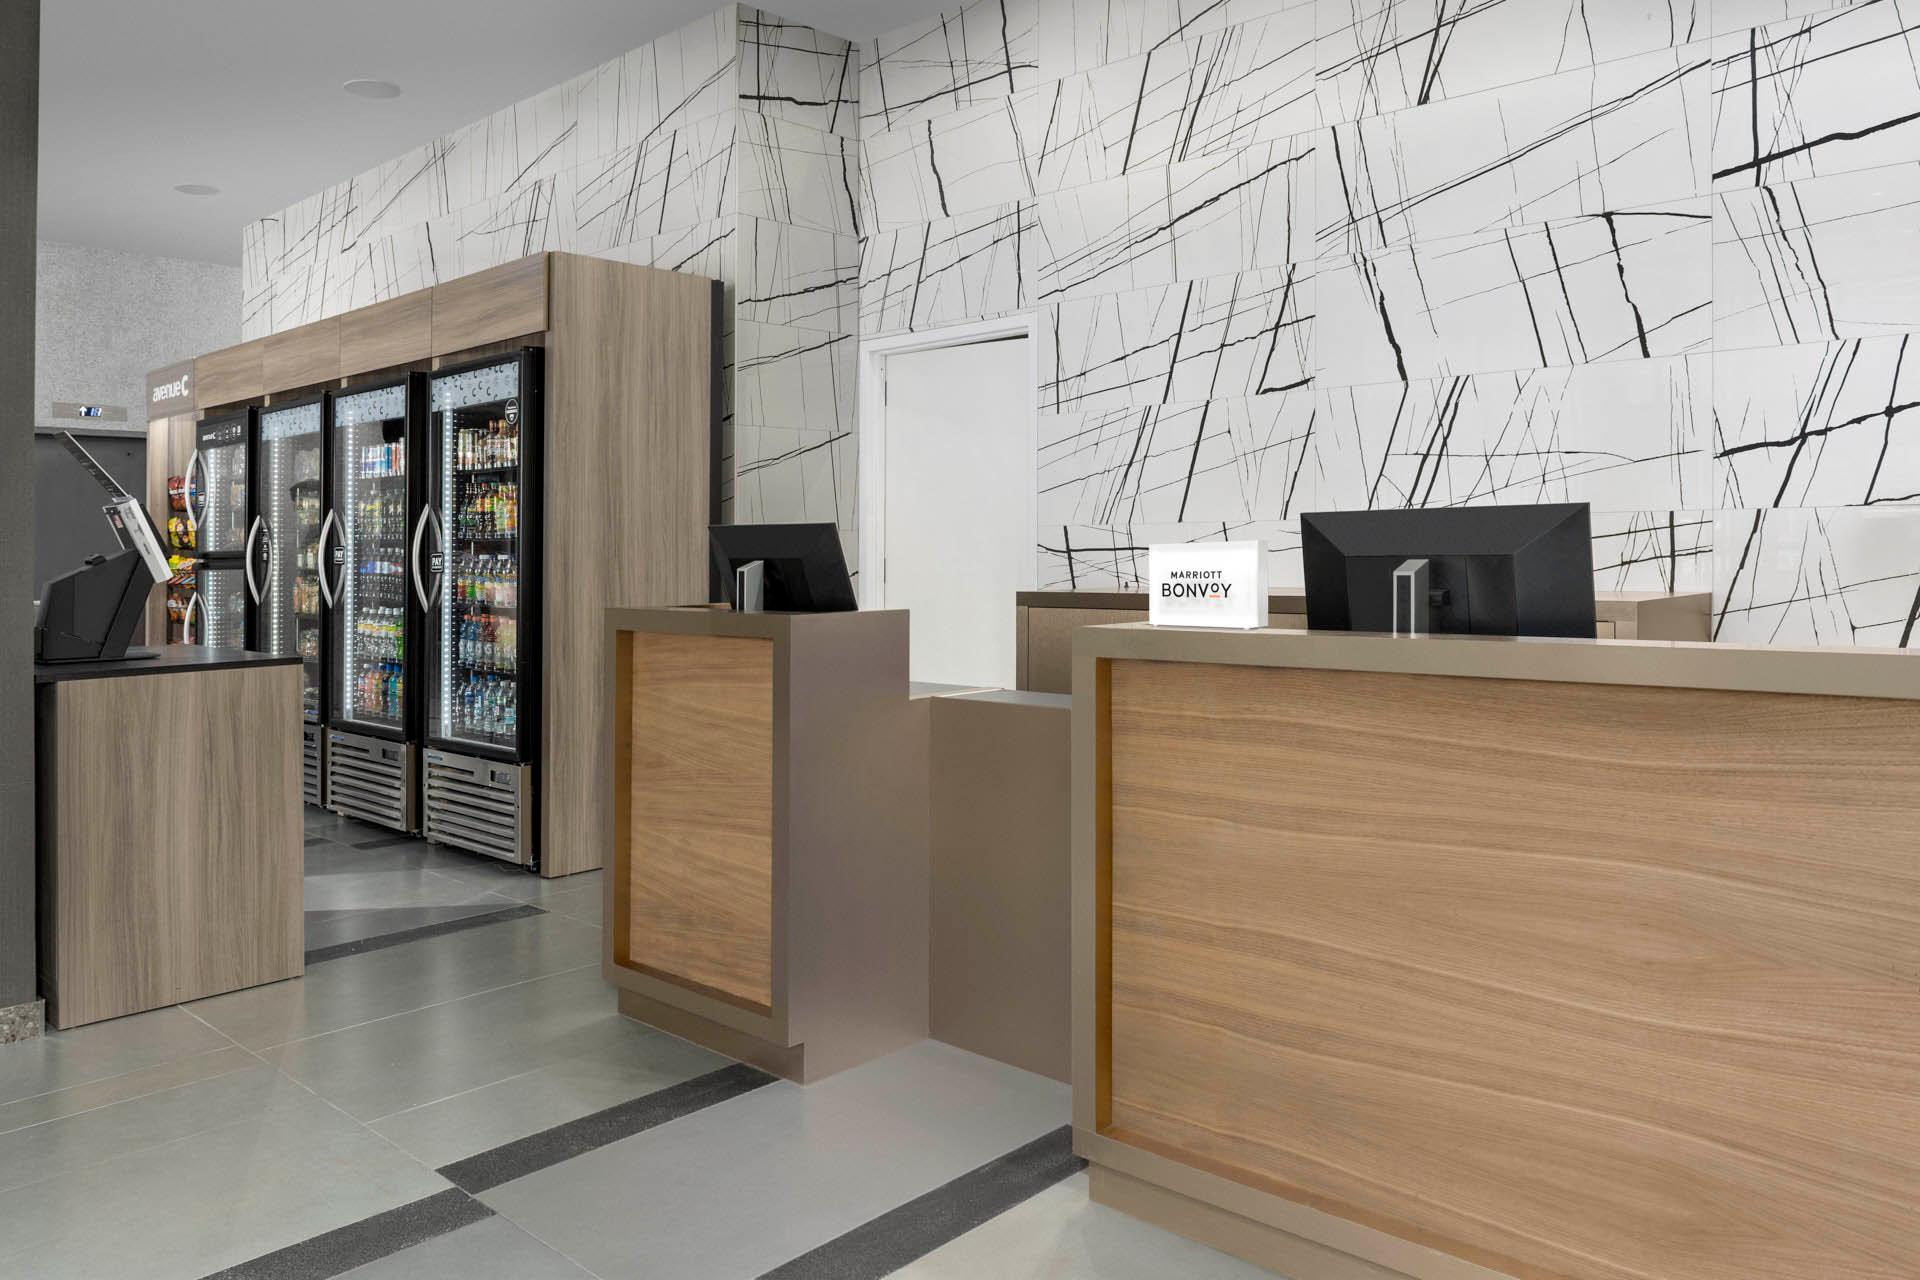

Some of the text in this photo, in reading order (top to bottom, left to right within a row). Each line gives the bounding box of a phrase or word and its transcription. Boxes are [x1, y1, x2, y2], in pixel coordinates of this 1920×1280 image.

[431, 557, 442, 566] PAY
[1170, 570, 1223, 580] MARRIOTT
[1161, 582, 1232, 598] BONVOY
